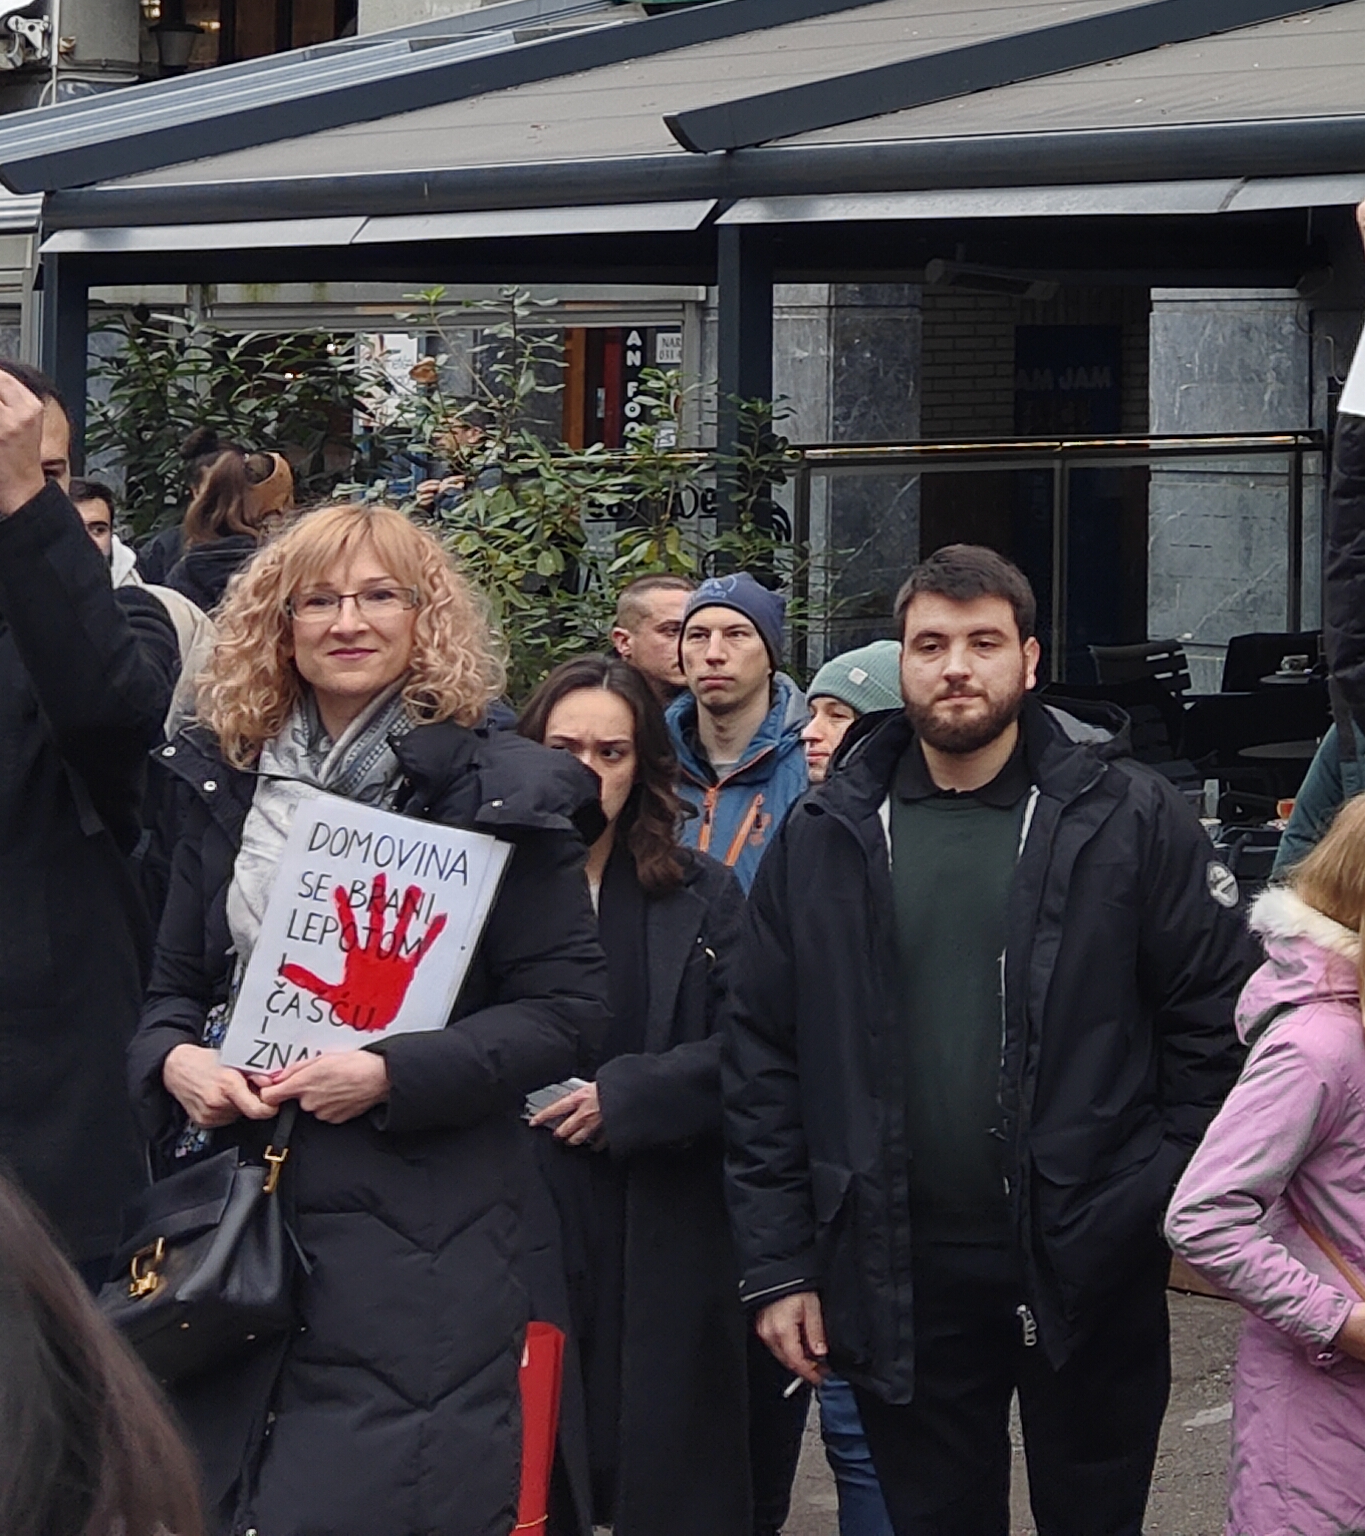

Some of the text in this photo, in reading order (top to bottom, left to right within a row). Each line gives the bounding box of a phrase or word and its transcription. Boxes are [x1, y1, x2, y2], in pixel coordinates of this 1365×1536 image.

[307, 821, 469, 885] DOMOVINA
[298, 871, 436, 925] SE BRANI
[287, 908, 424, 967] LEPOTOM
[245, 1039, 321, 1070] ZN
